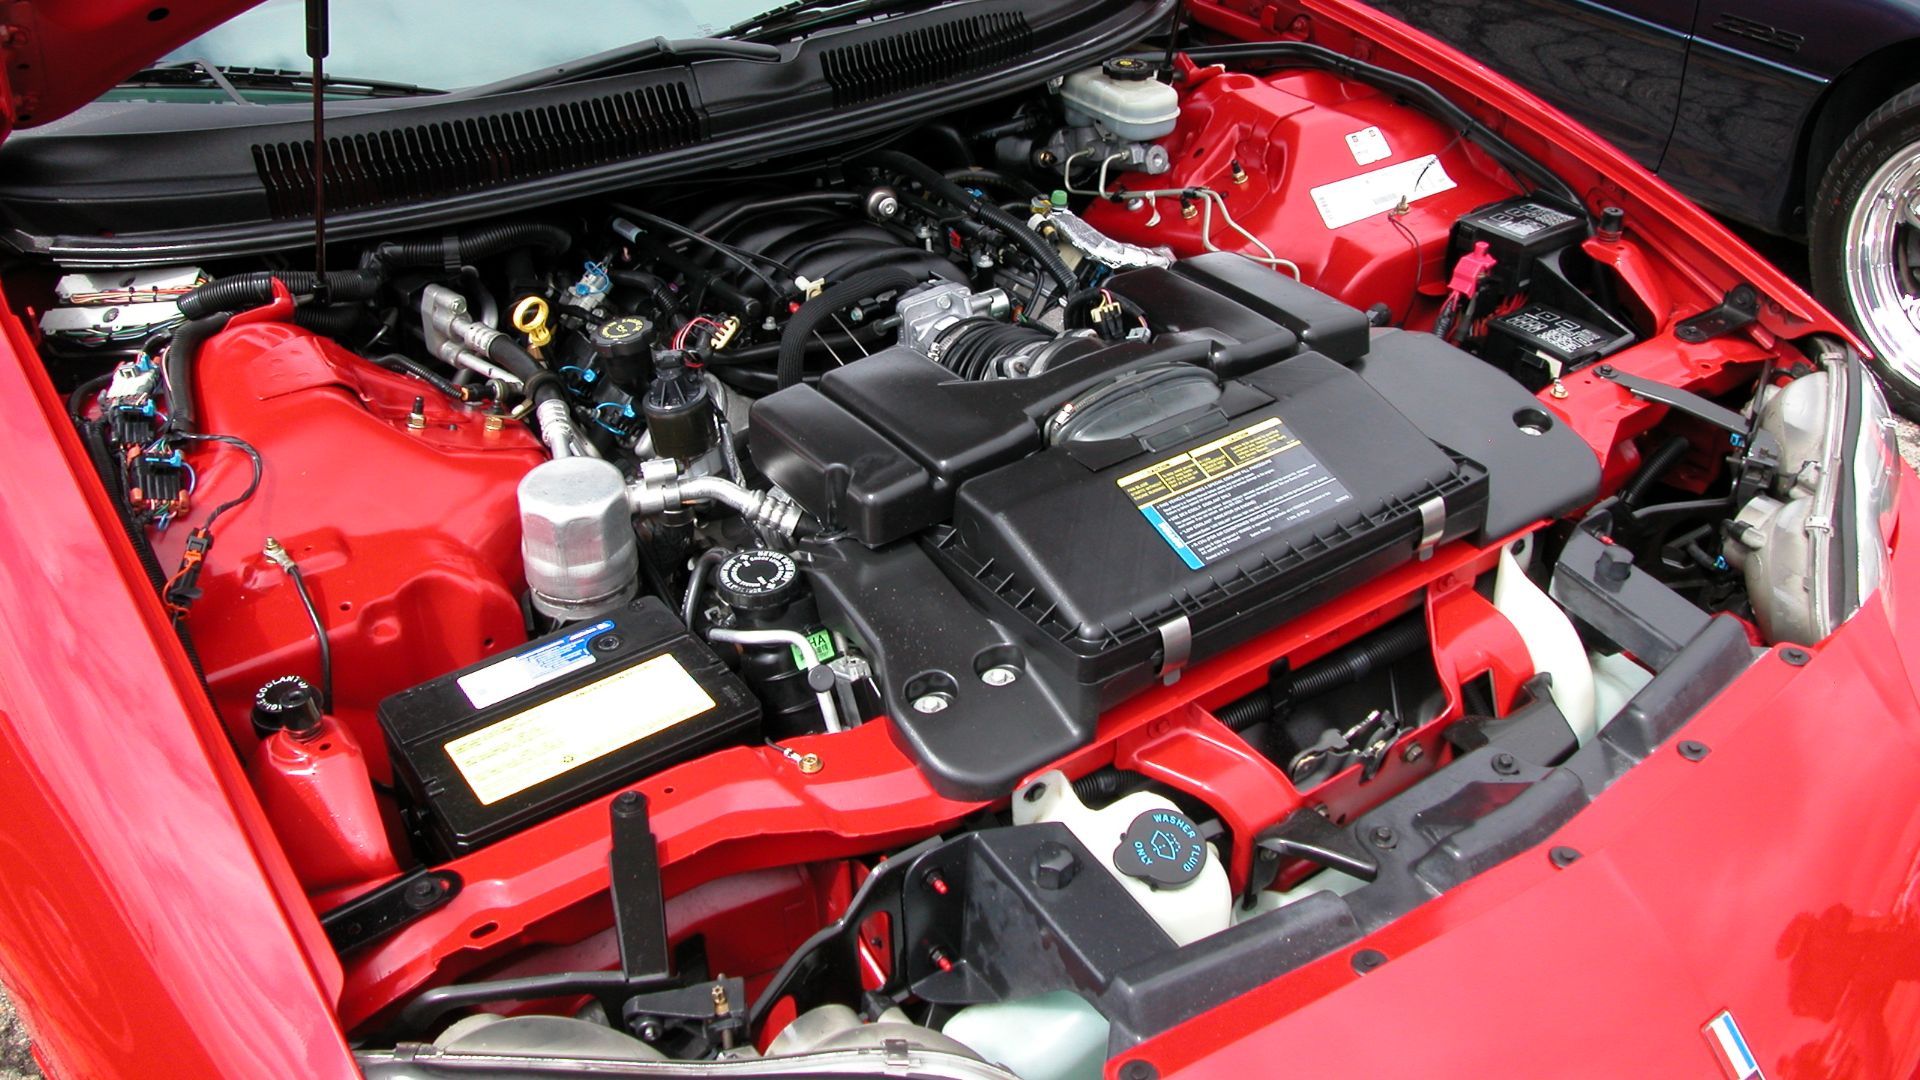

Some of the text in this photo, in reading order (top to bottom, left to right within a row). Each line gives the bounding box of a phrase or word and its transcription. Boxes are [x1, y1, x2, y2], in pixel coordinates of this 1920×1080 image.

[1134, 841, 1153, 866] ONLY
[1152, 814, 1201, 872] WASHER FLUID
